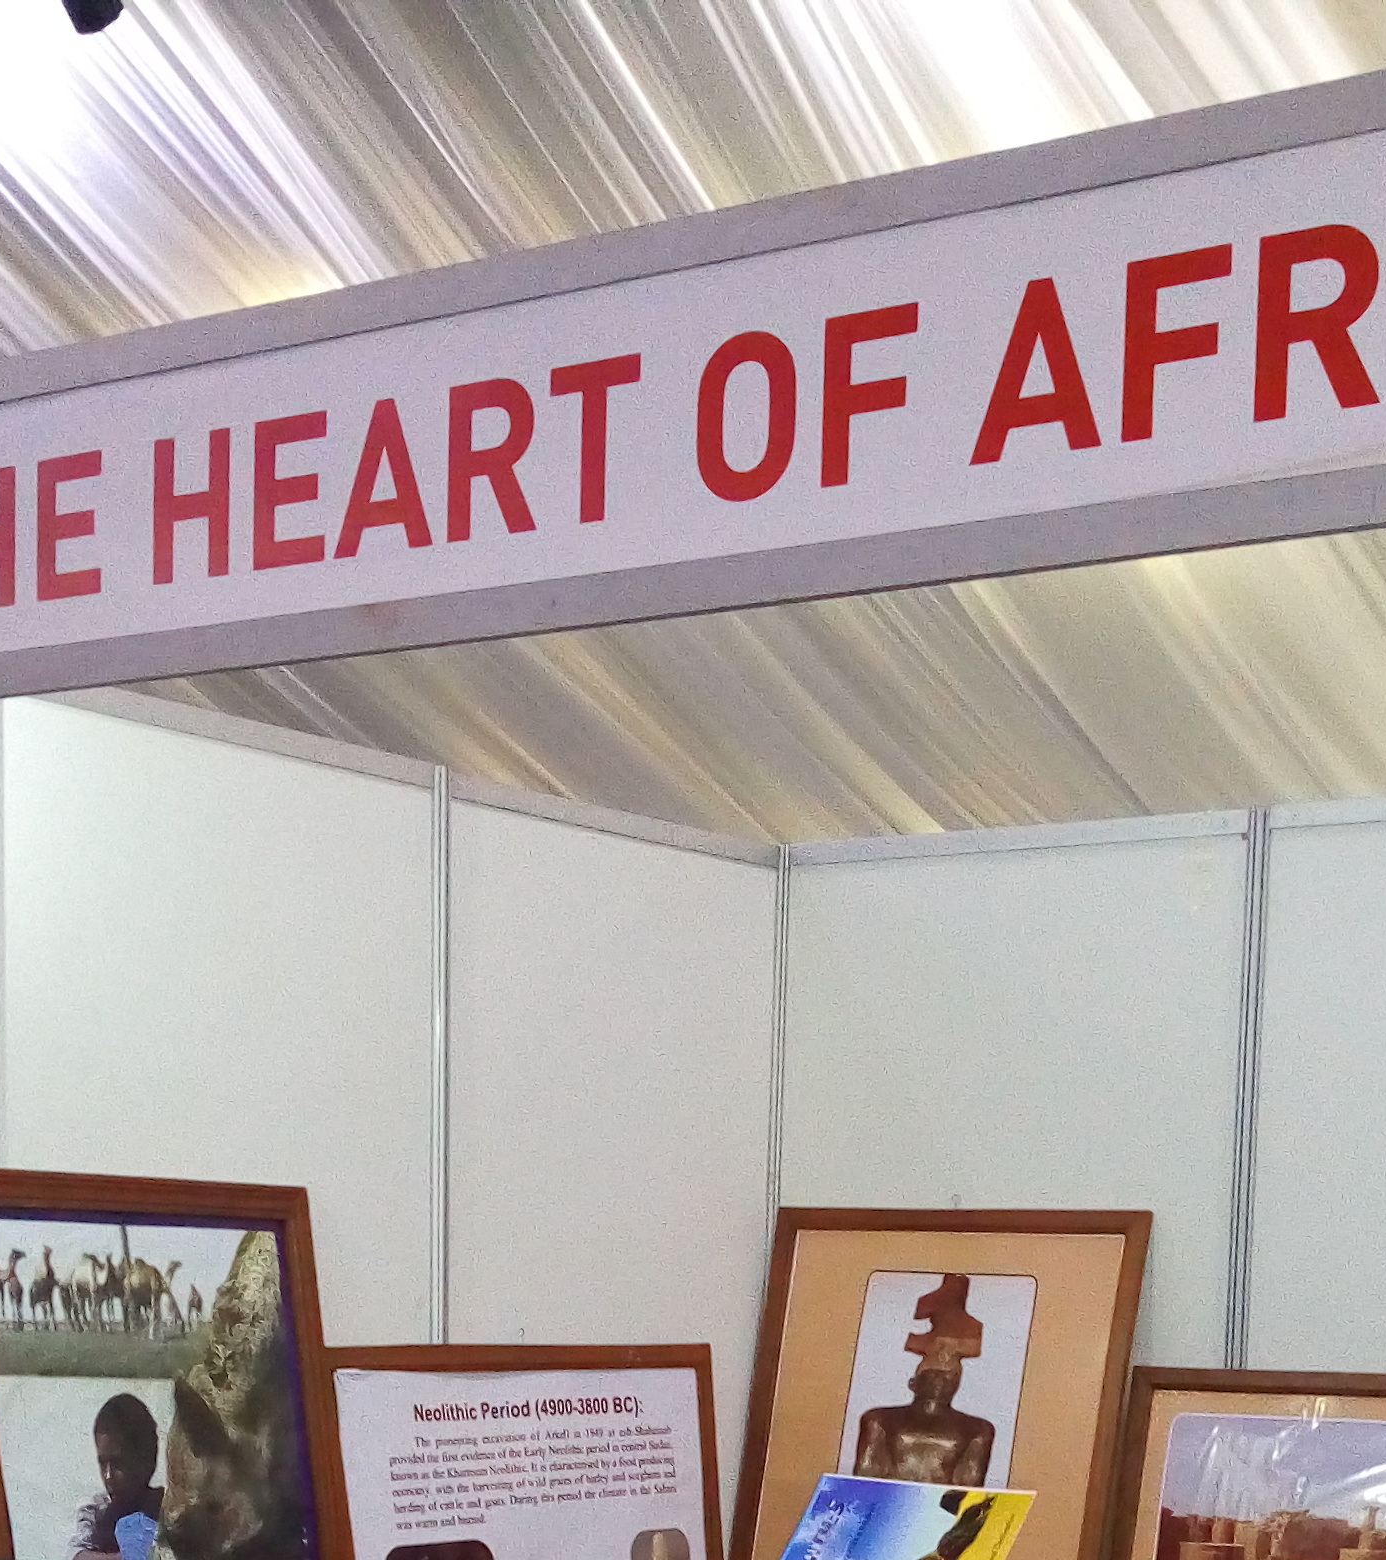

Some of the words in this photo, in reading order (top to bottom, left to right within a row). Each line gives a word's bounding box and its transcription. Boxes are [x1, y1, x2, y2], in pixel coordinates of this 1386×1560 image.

[153, 352, 643, 586] HEART
[696, 301, 920, 504] OF
[413, 1402, 477, 1422] Neolithic
[481, 1400, 531, 1420] Period
[535, 1398, 608, 1421] (4900-3800
[613, 1396, 644, 1418] BC):
